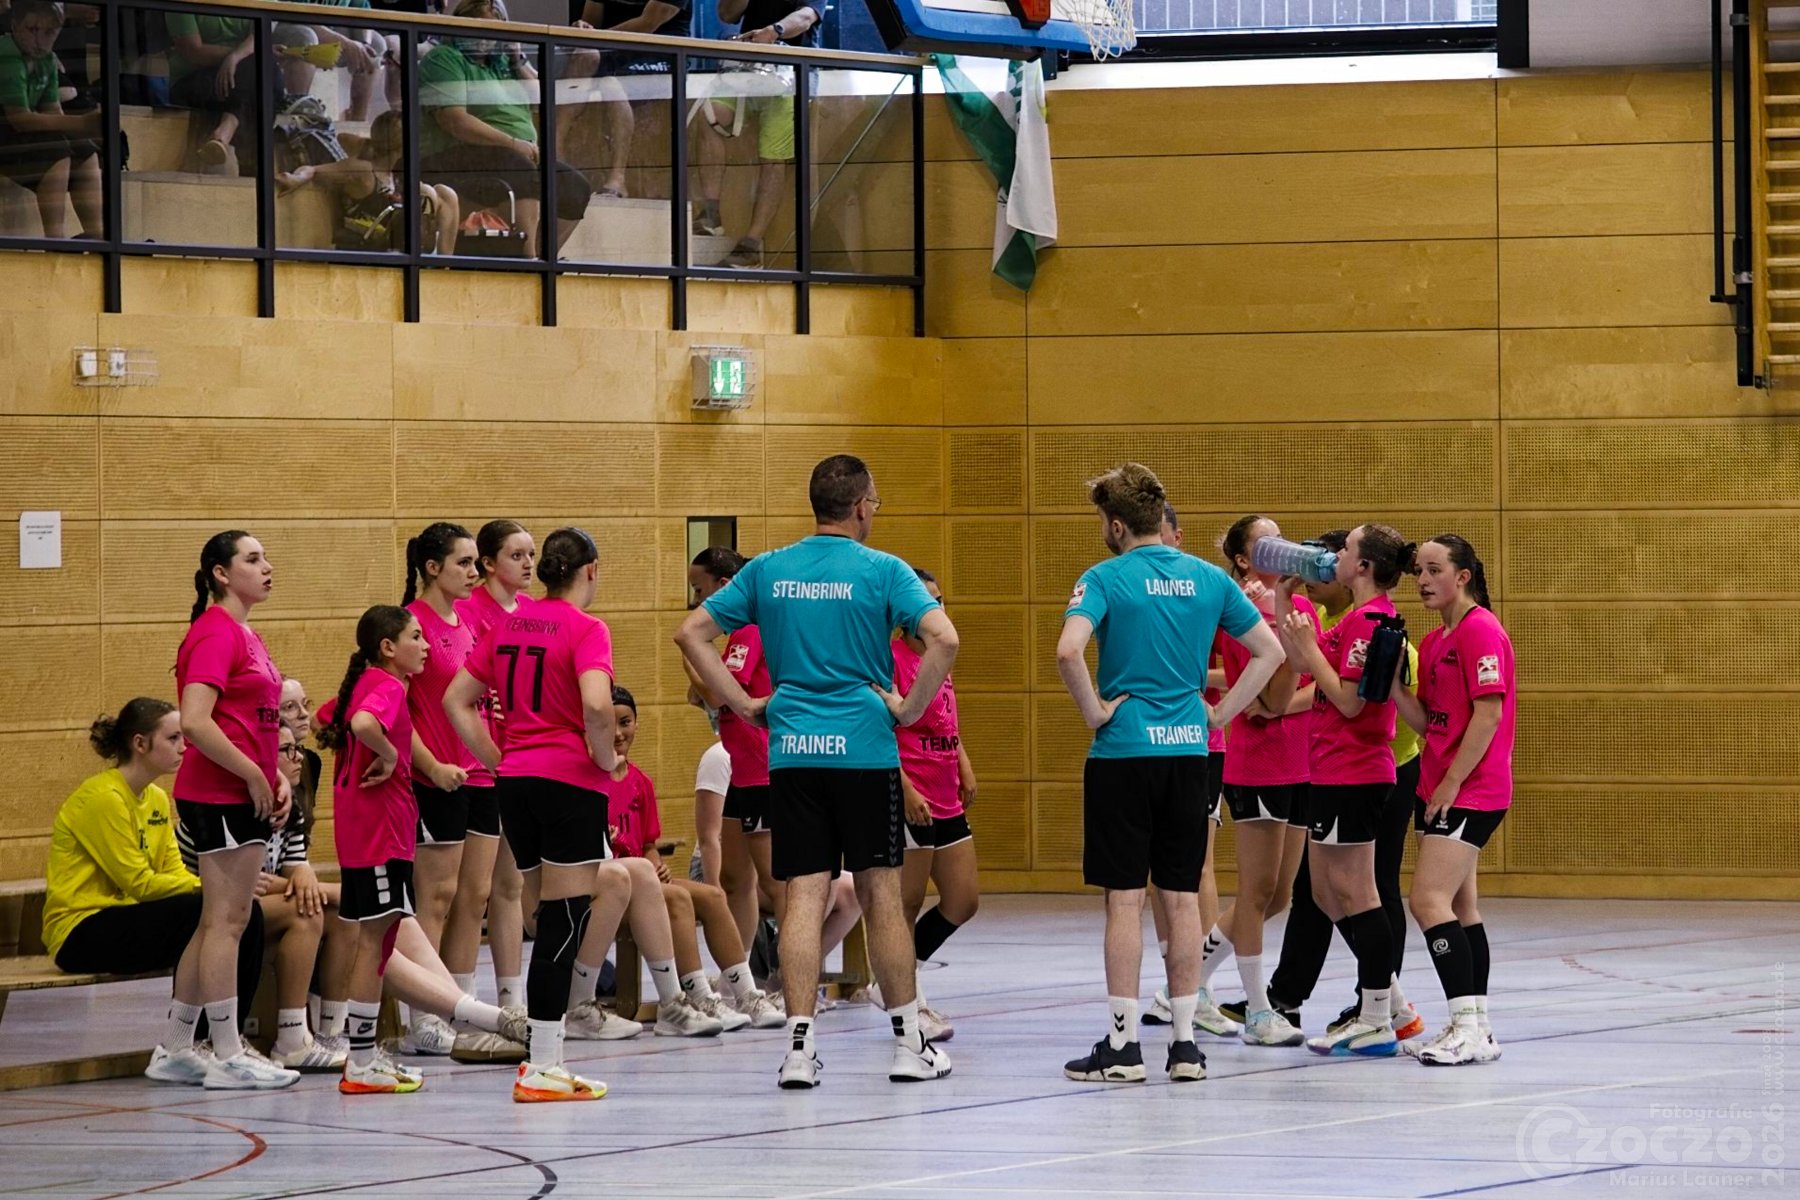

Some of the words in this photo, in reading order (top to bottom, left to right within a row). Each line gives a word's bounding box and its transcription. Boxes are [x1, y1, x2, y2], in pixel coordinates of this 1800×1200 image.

[772, 580, 854, 601] STEINBRINK
[1146, 578, 1196, 597] LAUNER
[496, 644, 547, 713] 77
[781, 734, 847, 756] TRAINER
[1146, 724, 1203, 746] TRAINER
